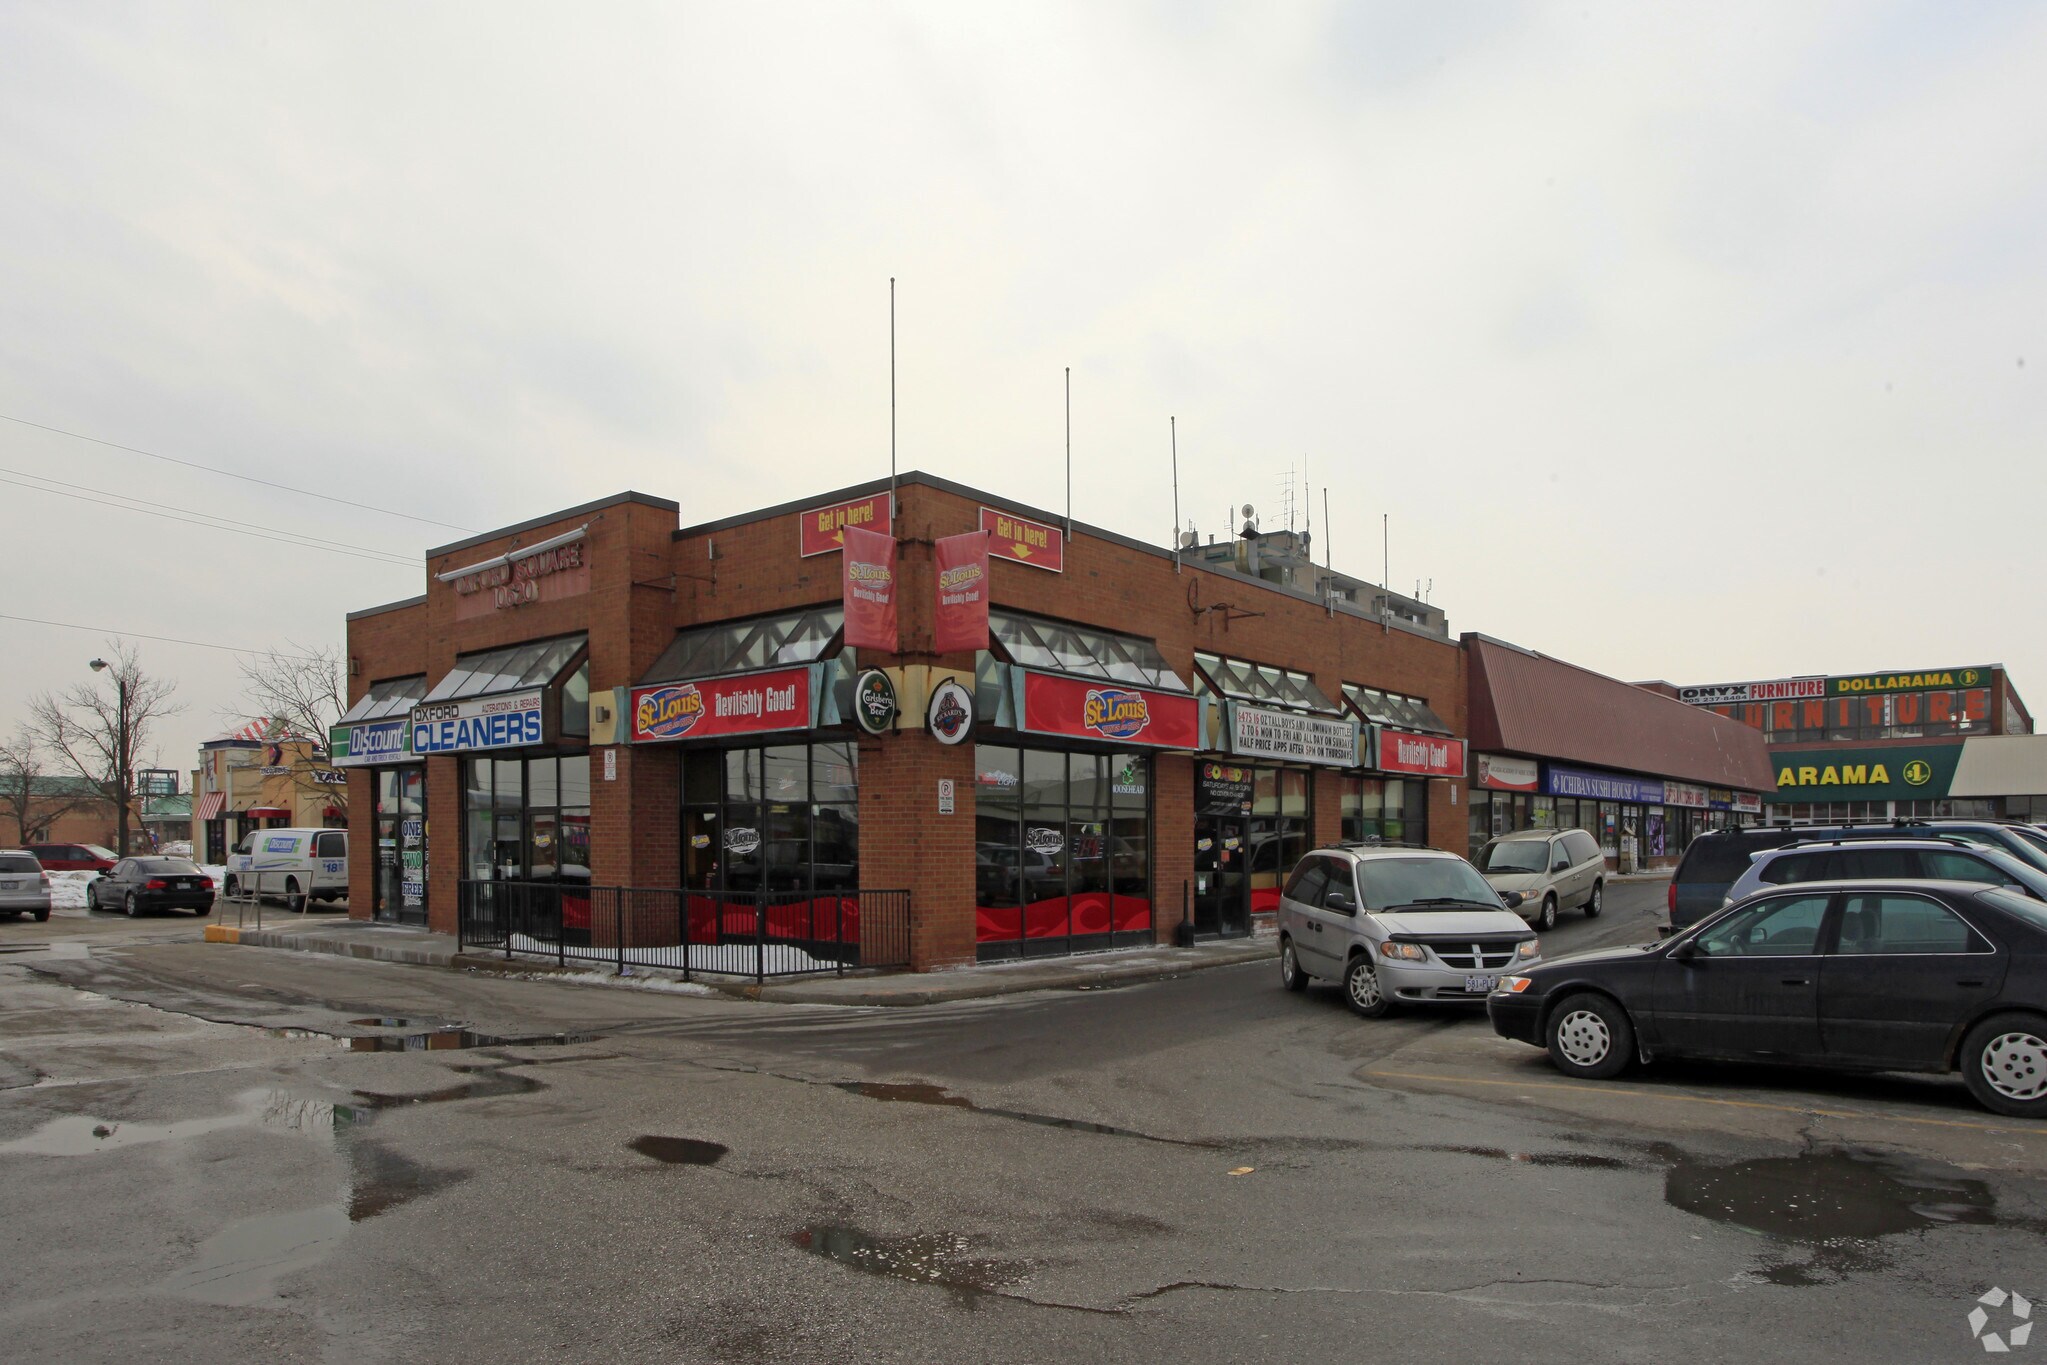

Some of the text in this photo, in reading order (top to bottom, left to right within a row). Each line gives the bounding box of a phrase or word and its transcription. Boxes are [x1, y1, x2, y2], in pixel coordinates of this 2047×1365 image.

[818, 501, 873, 532] Get in here!
[997, 517, 1047, 548] Get in here!
[514, 542, 583, 581] SQUARE
[864, 567, 891, 580] Louis
[952, 567, 981, 584] Louis
[494, 580, 539, 609] 10620
[1682, 680, 1823, 699] ONYX FURNITURE
[1838, 673, 1954, 692] DOLLARAMA
[482, 697, 540, 713] ALTERATIONS & REPAIRS
[715, 684, 796, 718] Devilishly Good!
[863, 689, 893, 708] Carlsberg
[414, 705, 459, 722] OXFORD
[639, 693, 700, 730] St. Louis
[870, 706, 886, 716] Beer
[1086, 697, 1145, 726] St. Louis
[414, 711, 541, 752] CLEANERS
[1241, 724, 1353, 749] 2 TO 6 MON TO FRI AND ALL DAY ON SUNDAYS
[1260, 714, 1268, 724] OZ
[1296, 720, 1305, 731] AND
[1333, 726, 1352, 737] BOTTLES
[351, 726, 404, 753] Discount
[1239, 737, 1352, 760] HALF PRICE APPS AFTER 5PM ON THURSDAYS
[1398, 738, 1448, 770] Devilishly Good!
[1776, 764, 1890, 787] ARAMA
[1560, 775, 1591, 795] ICHIBAN
[1591, 779, 1611, 798] SUSHI
[1612, 781, 1632, 800] HOUSE
[402, 820, 422, 837] ONE
[402, 851, 422, 869] TWO
[402, 881, 423, 897] FREE
